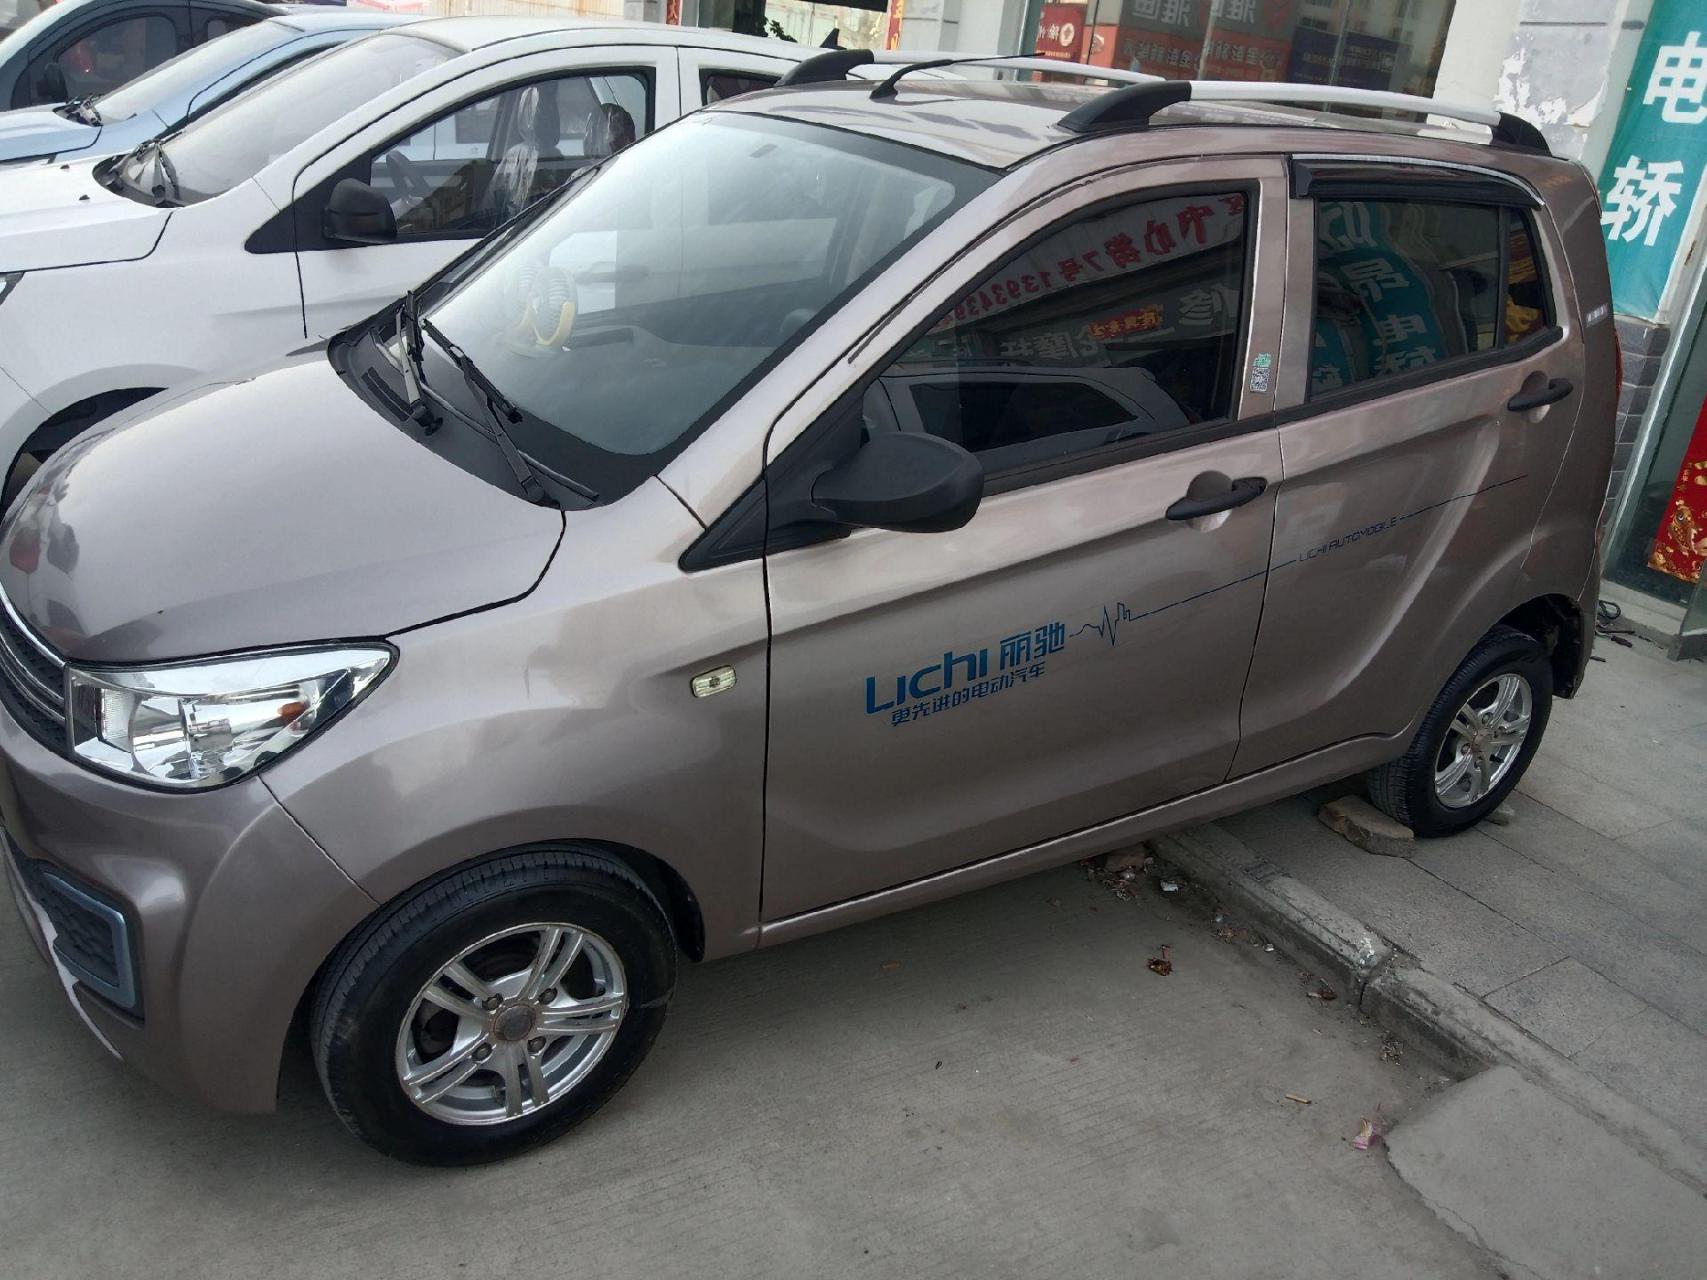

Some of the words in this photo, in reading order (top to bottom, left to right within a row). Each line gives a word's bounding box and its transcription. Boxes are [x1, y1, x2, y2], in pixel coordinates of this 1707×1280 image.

[1000, 622, 1066, 671] 丽驰
[891, 661, 1047, 727] 更先进的电动汽车
